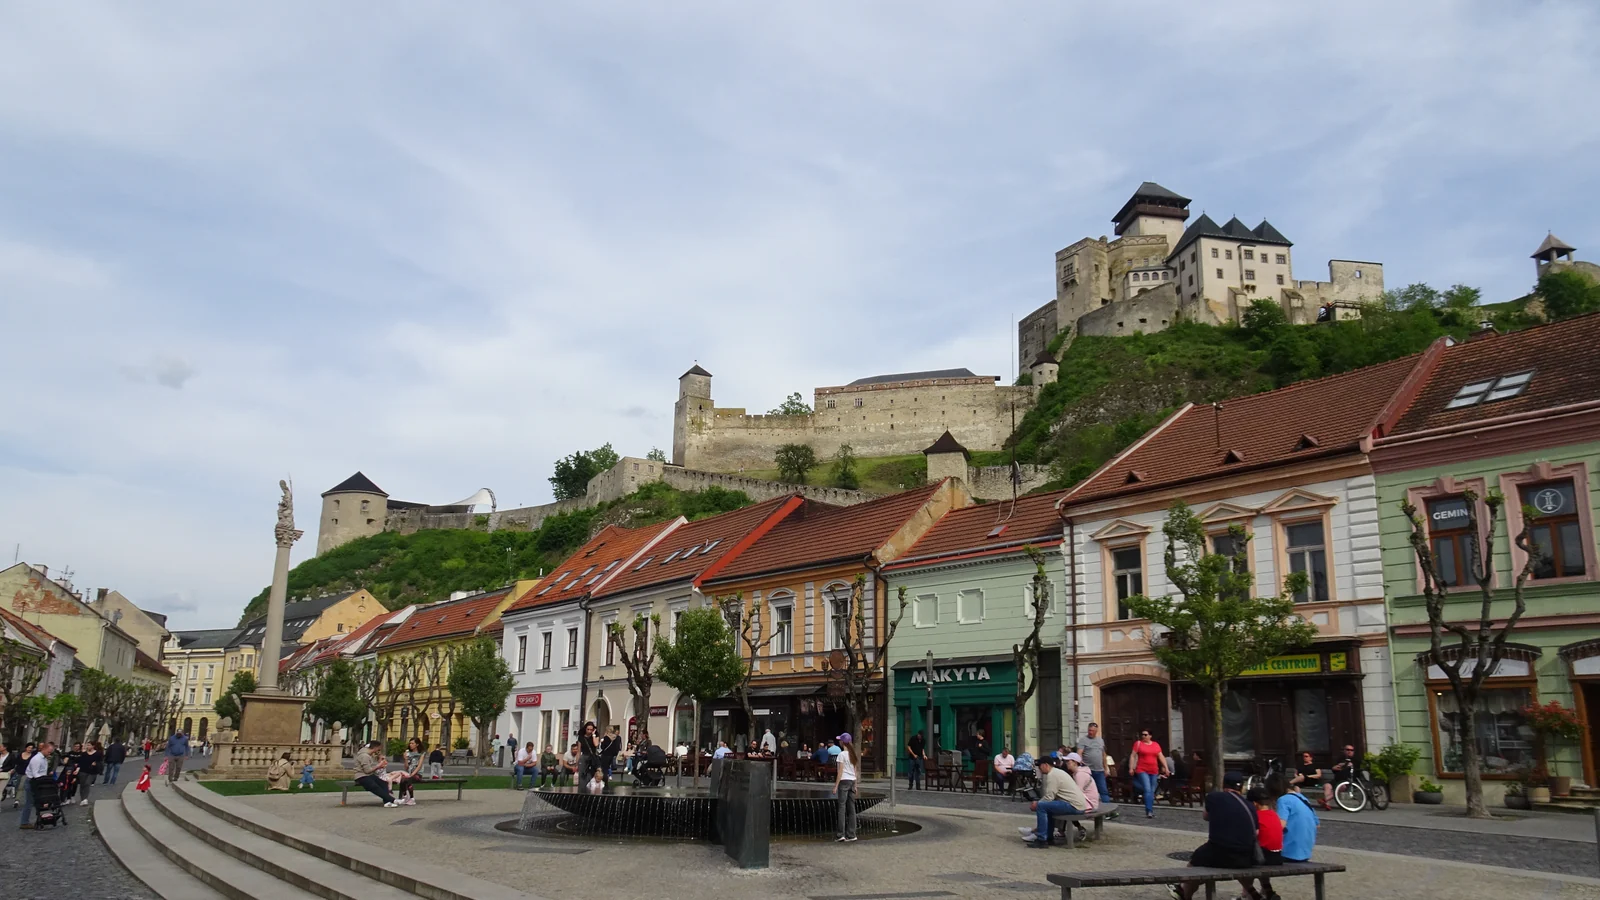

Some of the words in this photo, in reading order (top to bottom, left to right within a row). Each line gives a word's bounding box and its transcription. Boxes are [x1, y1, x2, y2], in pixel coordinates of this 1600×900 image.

[1433, 508, 1468, 520] GEMIN
[1271, 658, 1317, 670] CENTRUM
[910, 667, 991, 683] MAKYTA
